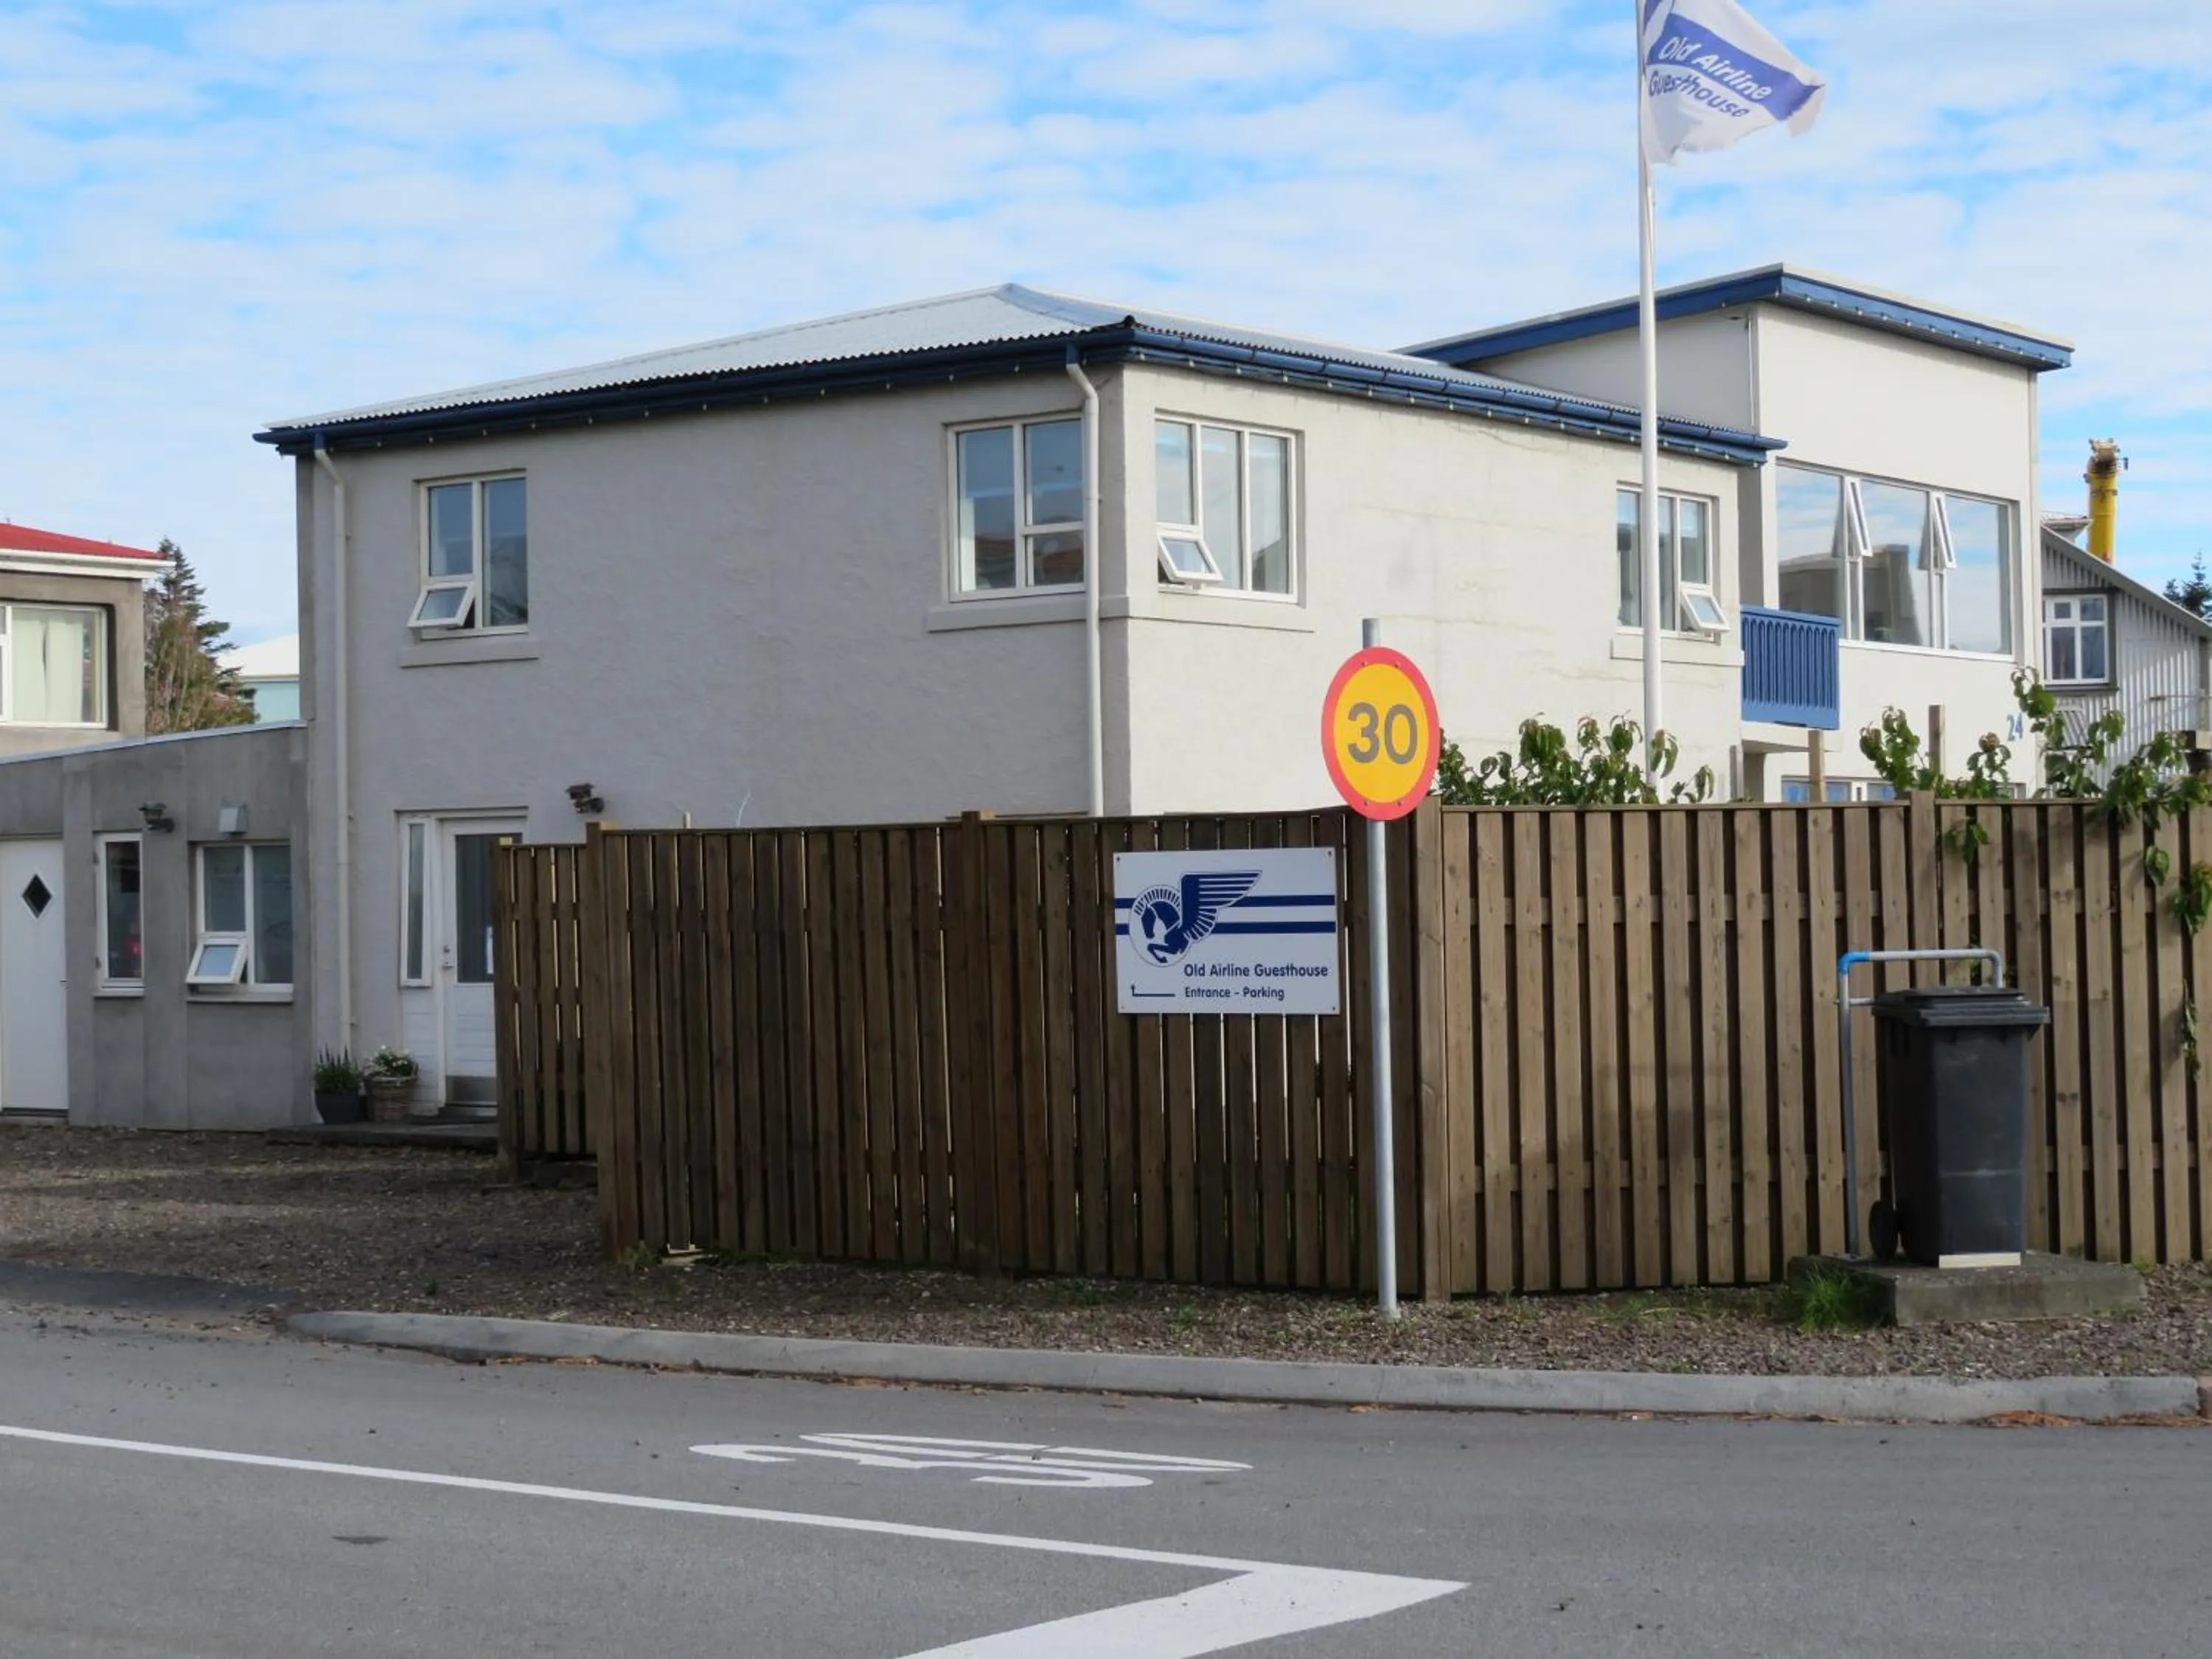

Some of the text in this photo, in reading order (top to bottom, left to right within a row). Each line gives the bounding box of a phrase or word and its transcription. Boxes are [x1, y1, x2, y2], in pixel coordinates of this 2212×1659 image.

[1658, 36, 1772, 100] Old Airline
[1649, 70, 1750, 118] Guesthouse
[1347, 701, 1418, 765] 30
[2006, 712, 2023, 742] 24
[1183, 963, 1329, 978] Old Airline Guesthouse
[1184, 986, 1231, 998] Entrance
[1242, 986, 1285, 1002] Parking
[689, 1433, 1253, 1488] 30
